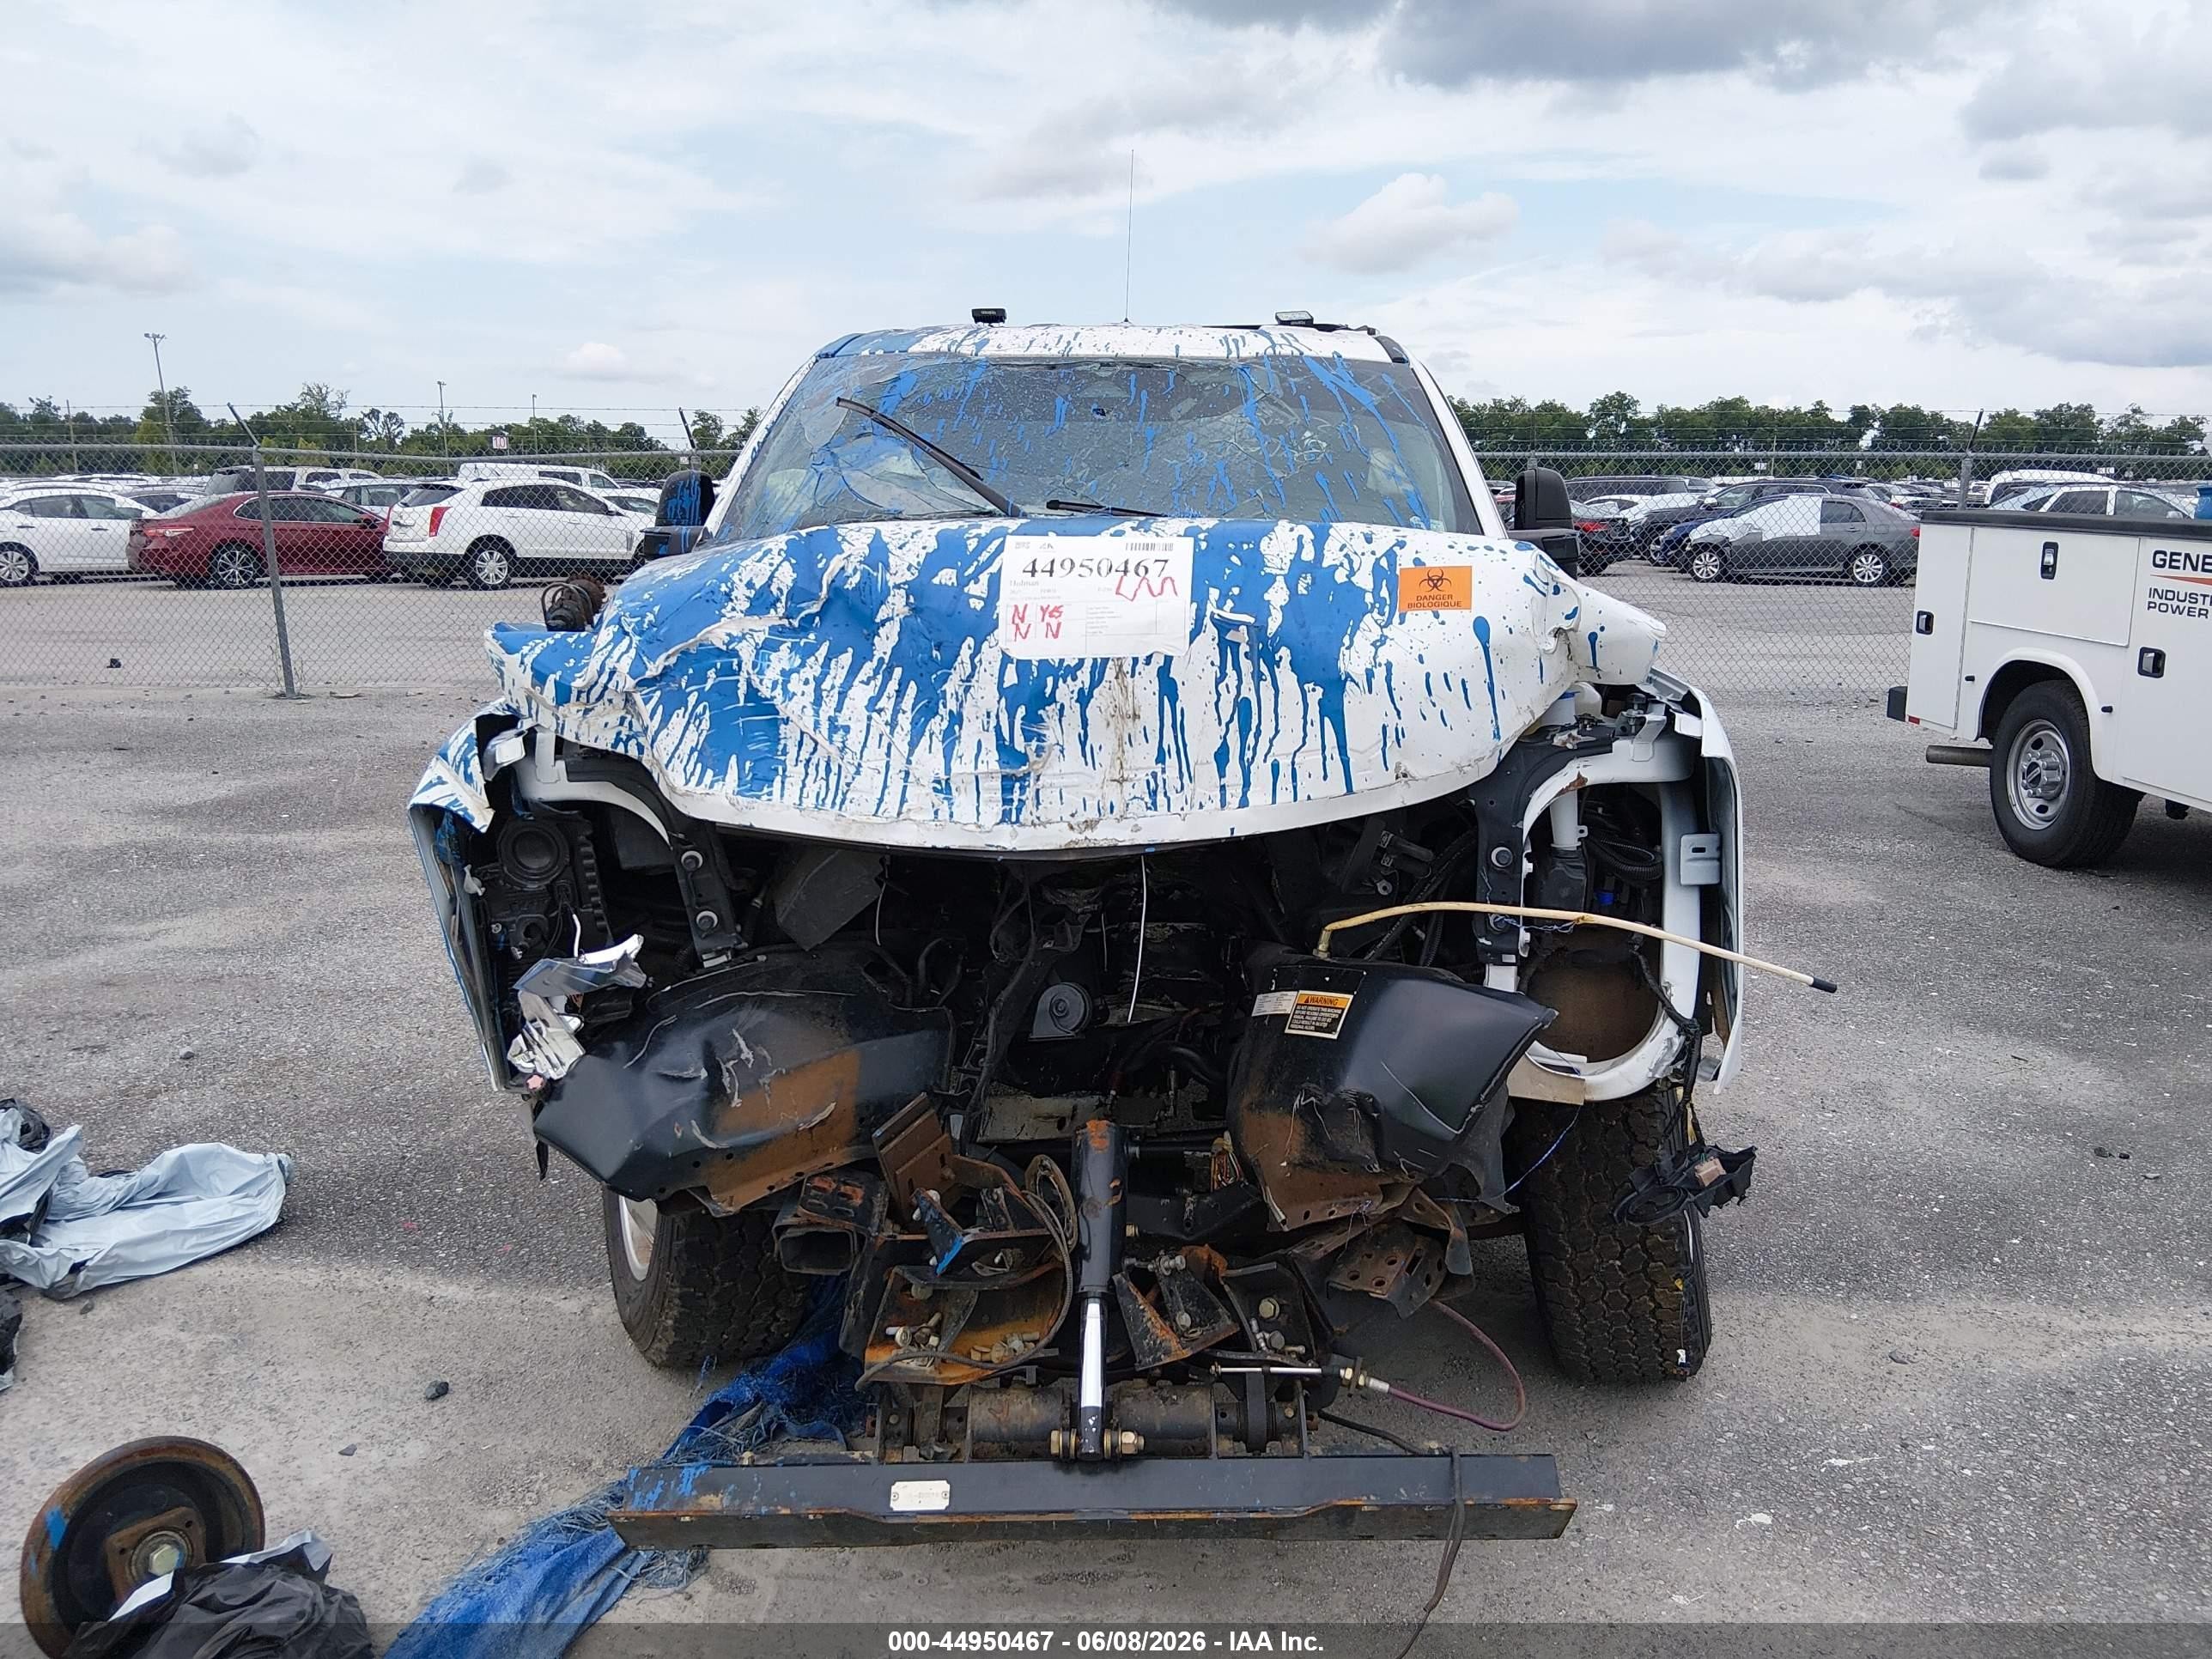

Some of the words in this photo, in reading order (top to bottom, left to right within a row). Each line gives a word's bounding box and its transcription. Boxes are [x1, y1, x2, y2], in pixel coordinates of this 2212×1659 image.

[1023, 558, 1169, 578] 44950467
[2153, 550, 2212, 573] GENE
[2148, 587, 2212, 606] INDUST
[1012, 604, 1028, 624] N
[2147, 601, 2209, 619] POWER
[1014, 623, 1031, 642] N
[1045, 622, 1062, 639] N
[1310, 995, 1339, 1006] WARNING
